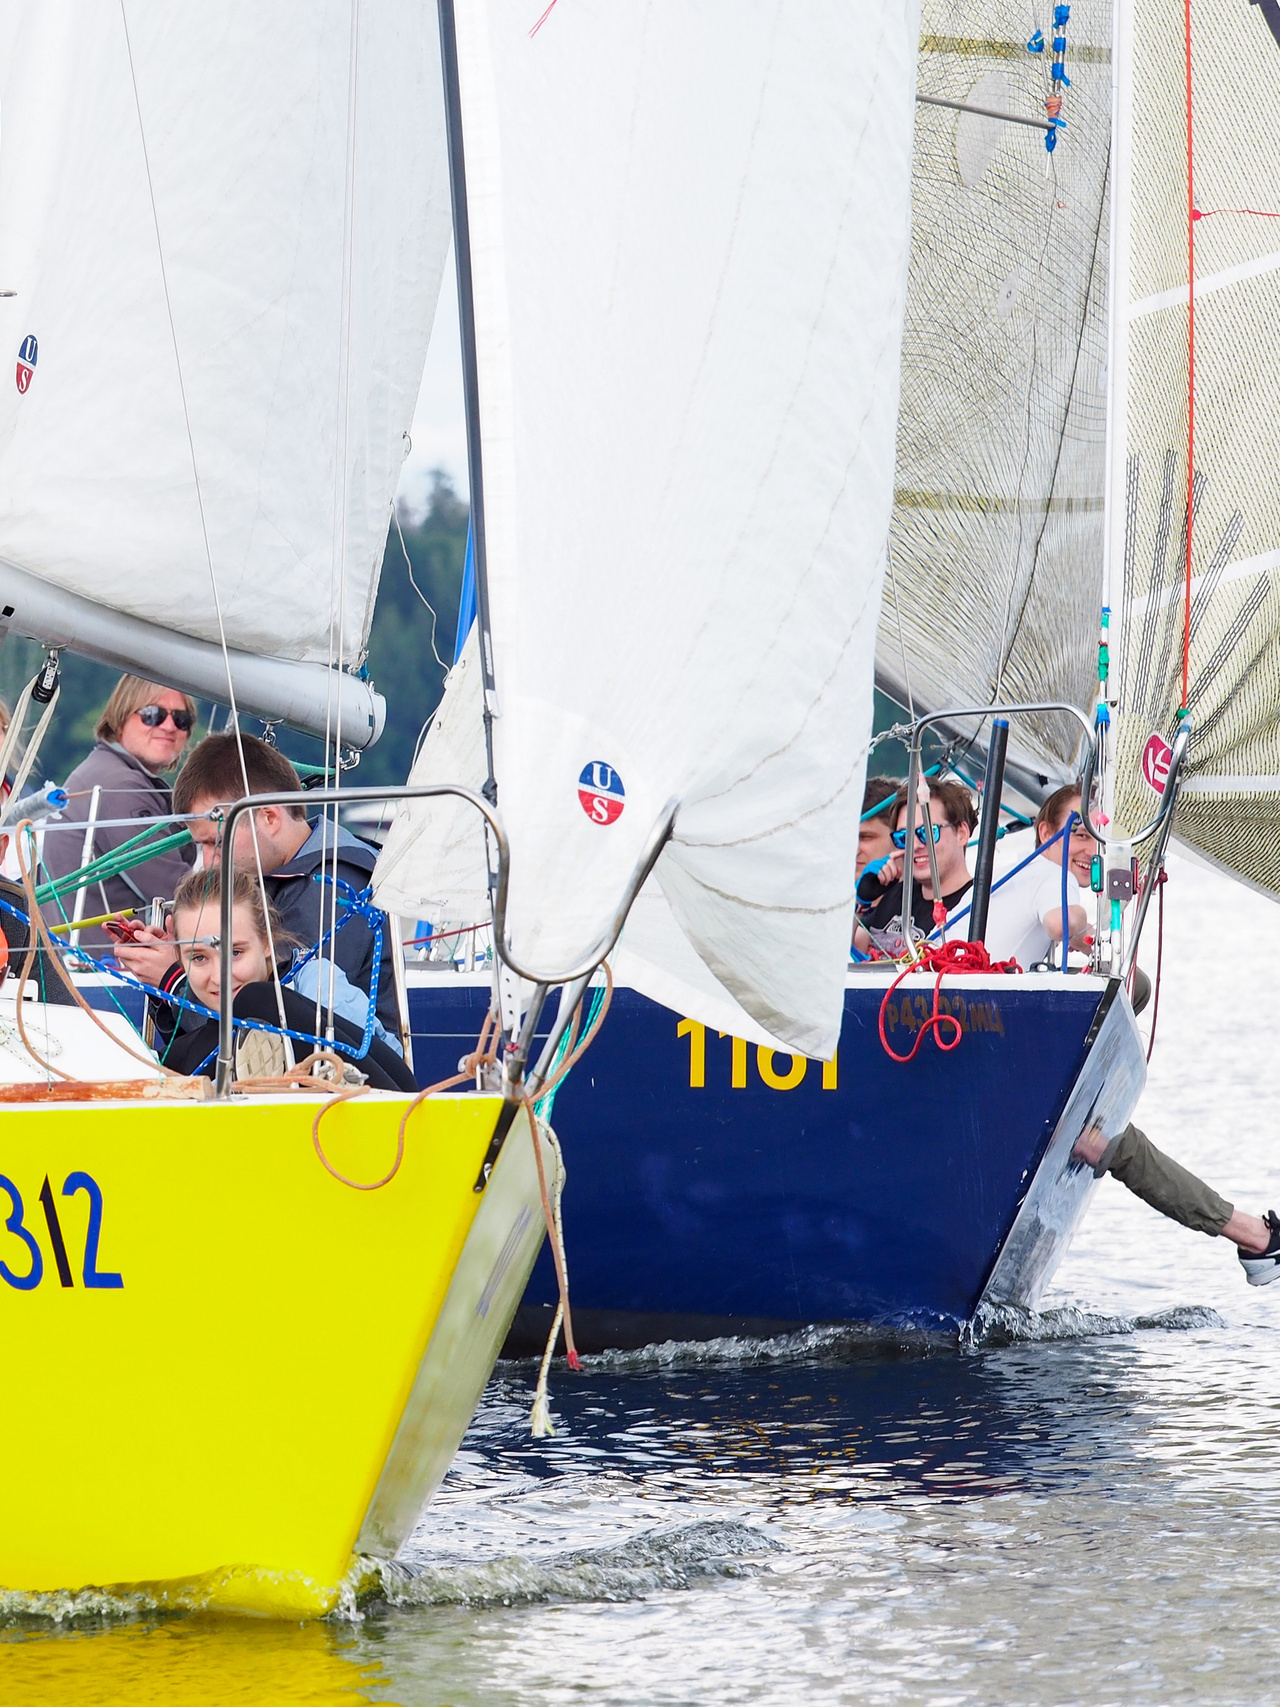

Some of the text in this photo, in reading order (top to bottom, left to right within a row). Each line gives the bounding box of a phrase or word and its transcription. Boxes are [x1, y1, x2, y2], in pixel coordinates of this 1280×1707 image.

[26, 336, 37, 361] U
[19, 369, 29, 391] S
[592, 763, 613, 790] U
[592, 797, 608, 822] S
